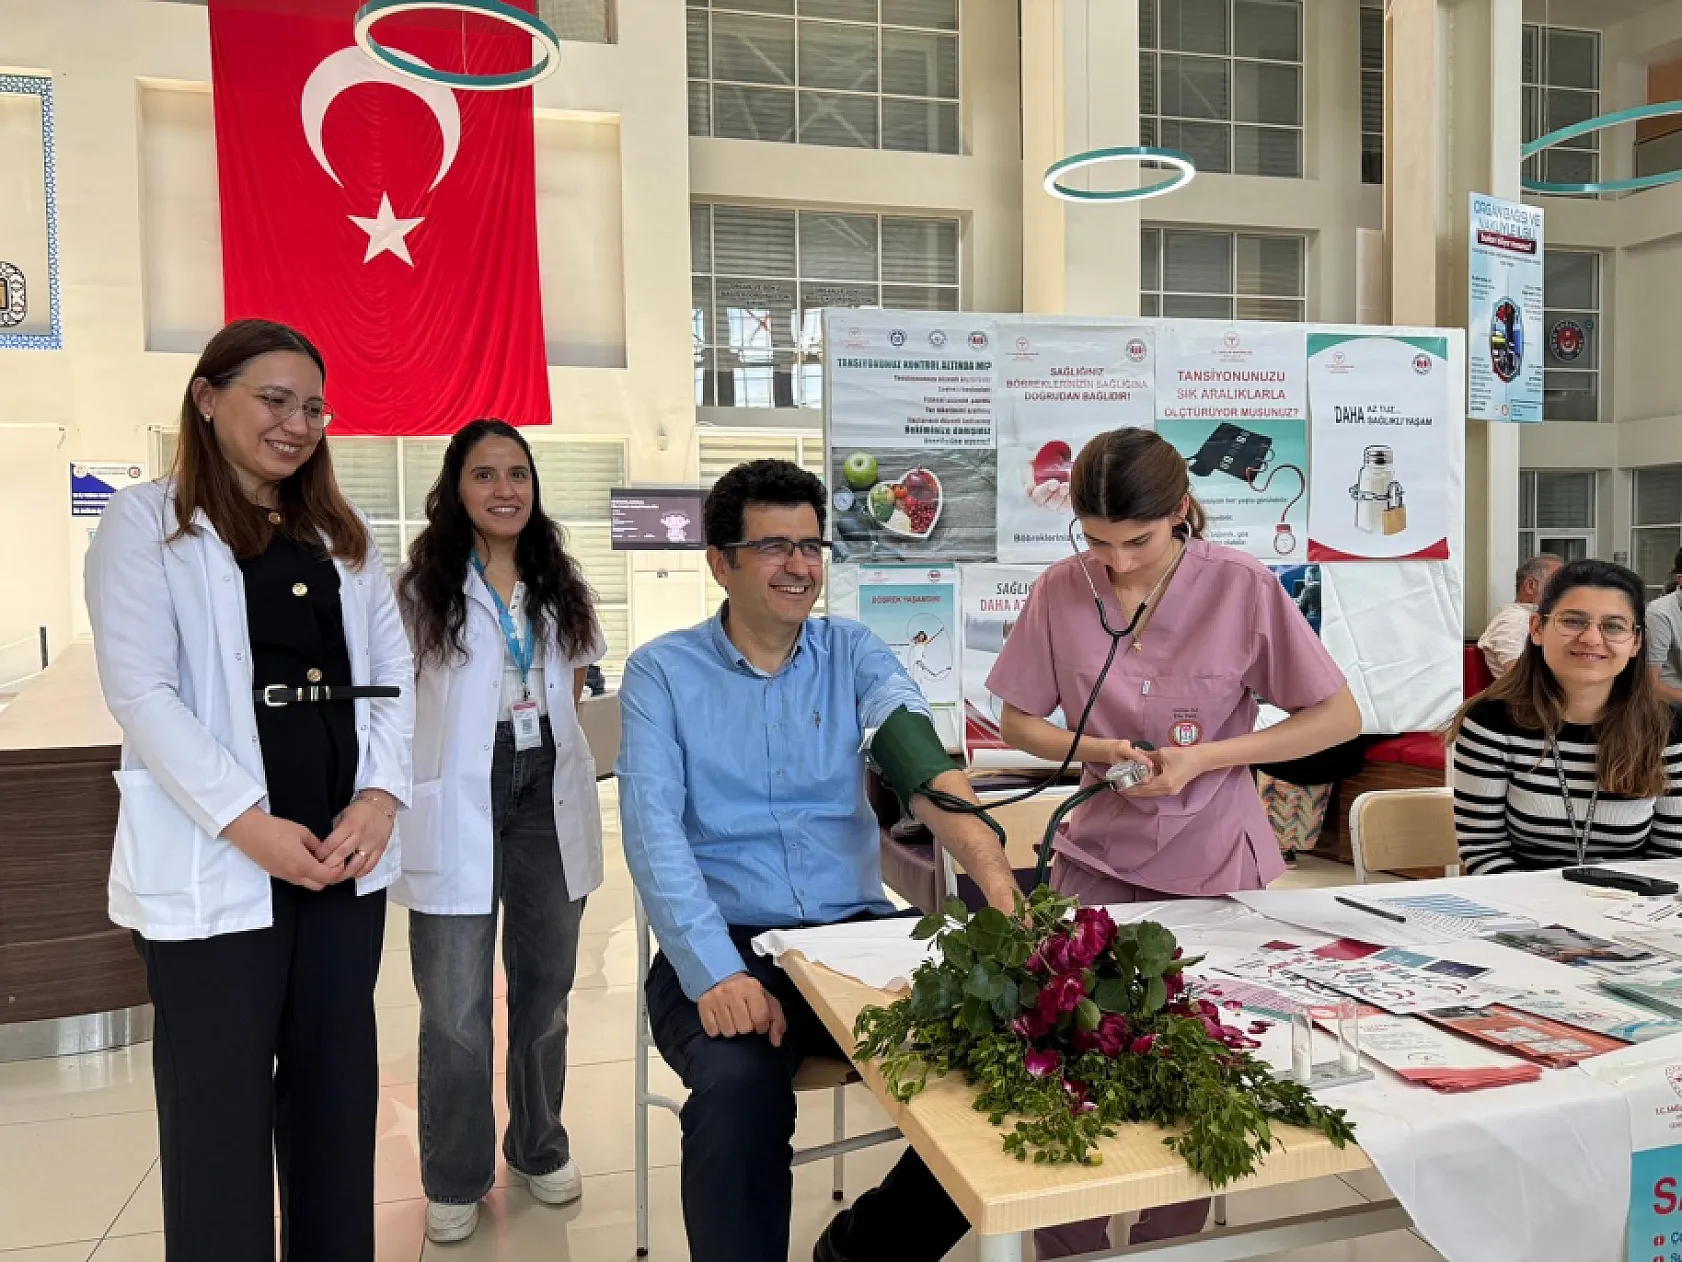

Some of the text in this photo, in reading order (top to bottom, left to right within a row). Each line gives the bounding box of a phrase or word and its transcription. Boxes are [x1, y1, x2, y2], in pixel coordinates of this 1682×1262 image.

[1177, 368, 1286, 382] TANSİYONUNUZU
[1024, 390, 1079, 401] DOĞRUDAN
[1177, 388, 1286, 400] SIK ARALIKLARLA
[1241, 407, 1299, 418] MUSUNUZ?
[1334, 405, 1365, 424] DAHA
[1367, 405, 1378, 413] AZ
[1366, 415, 1433, 427] SAĞLIKLI YAŞAM
[980, 599, 1011, 611] DAHA
